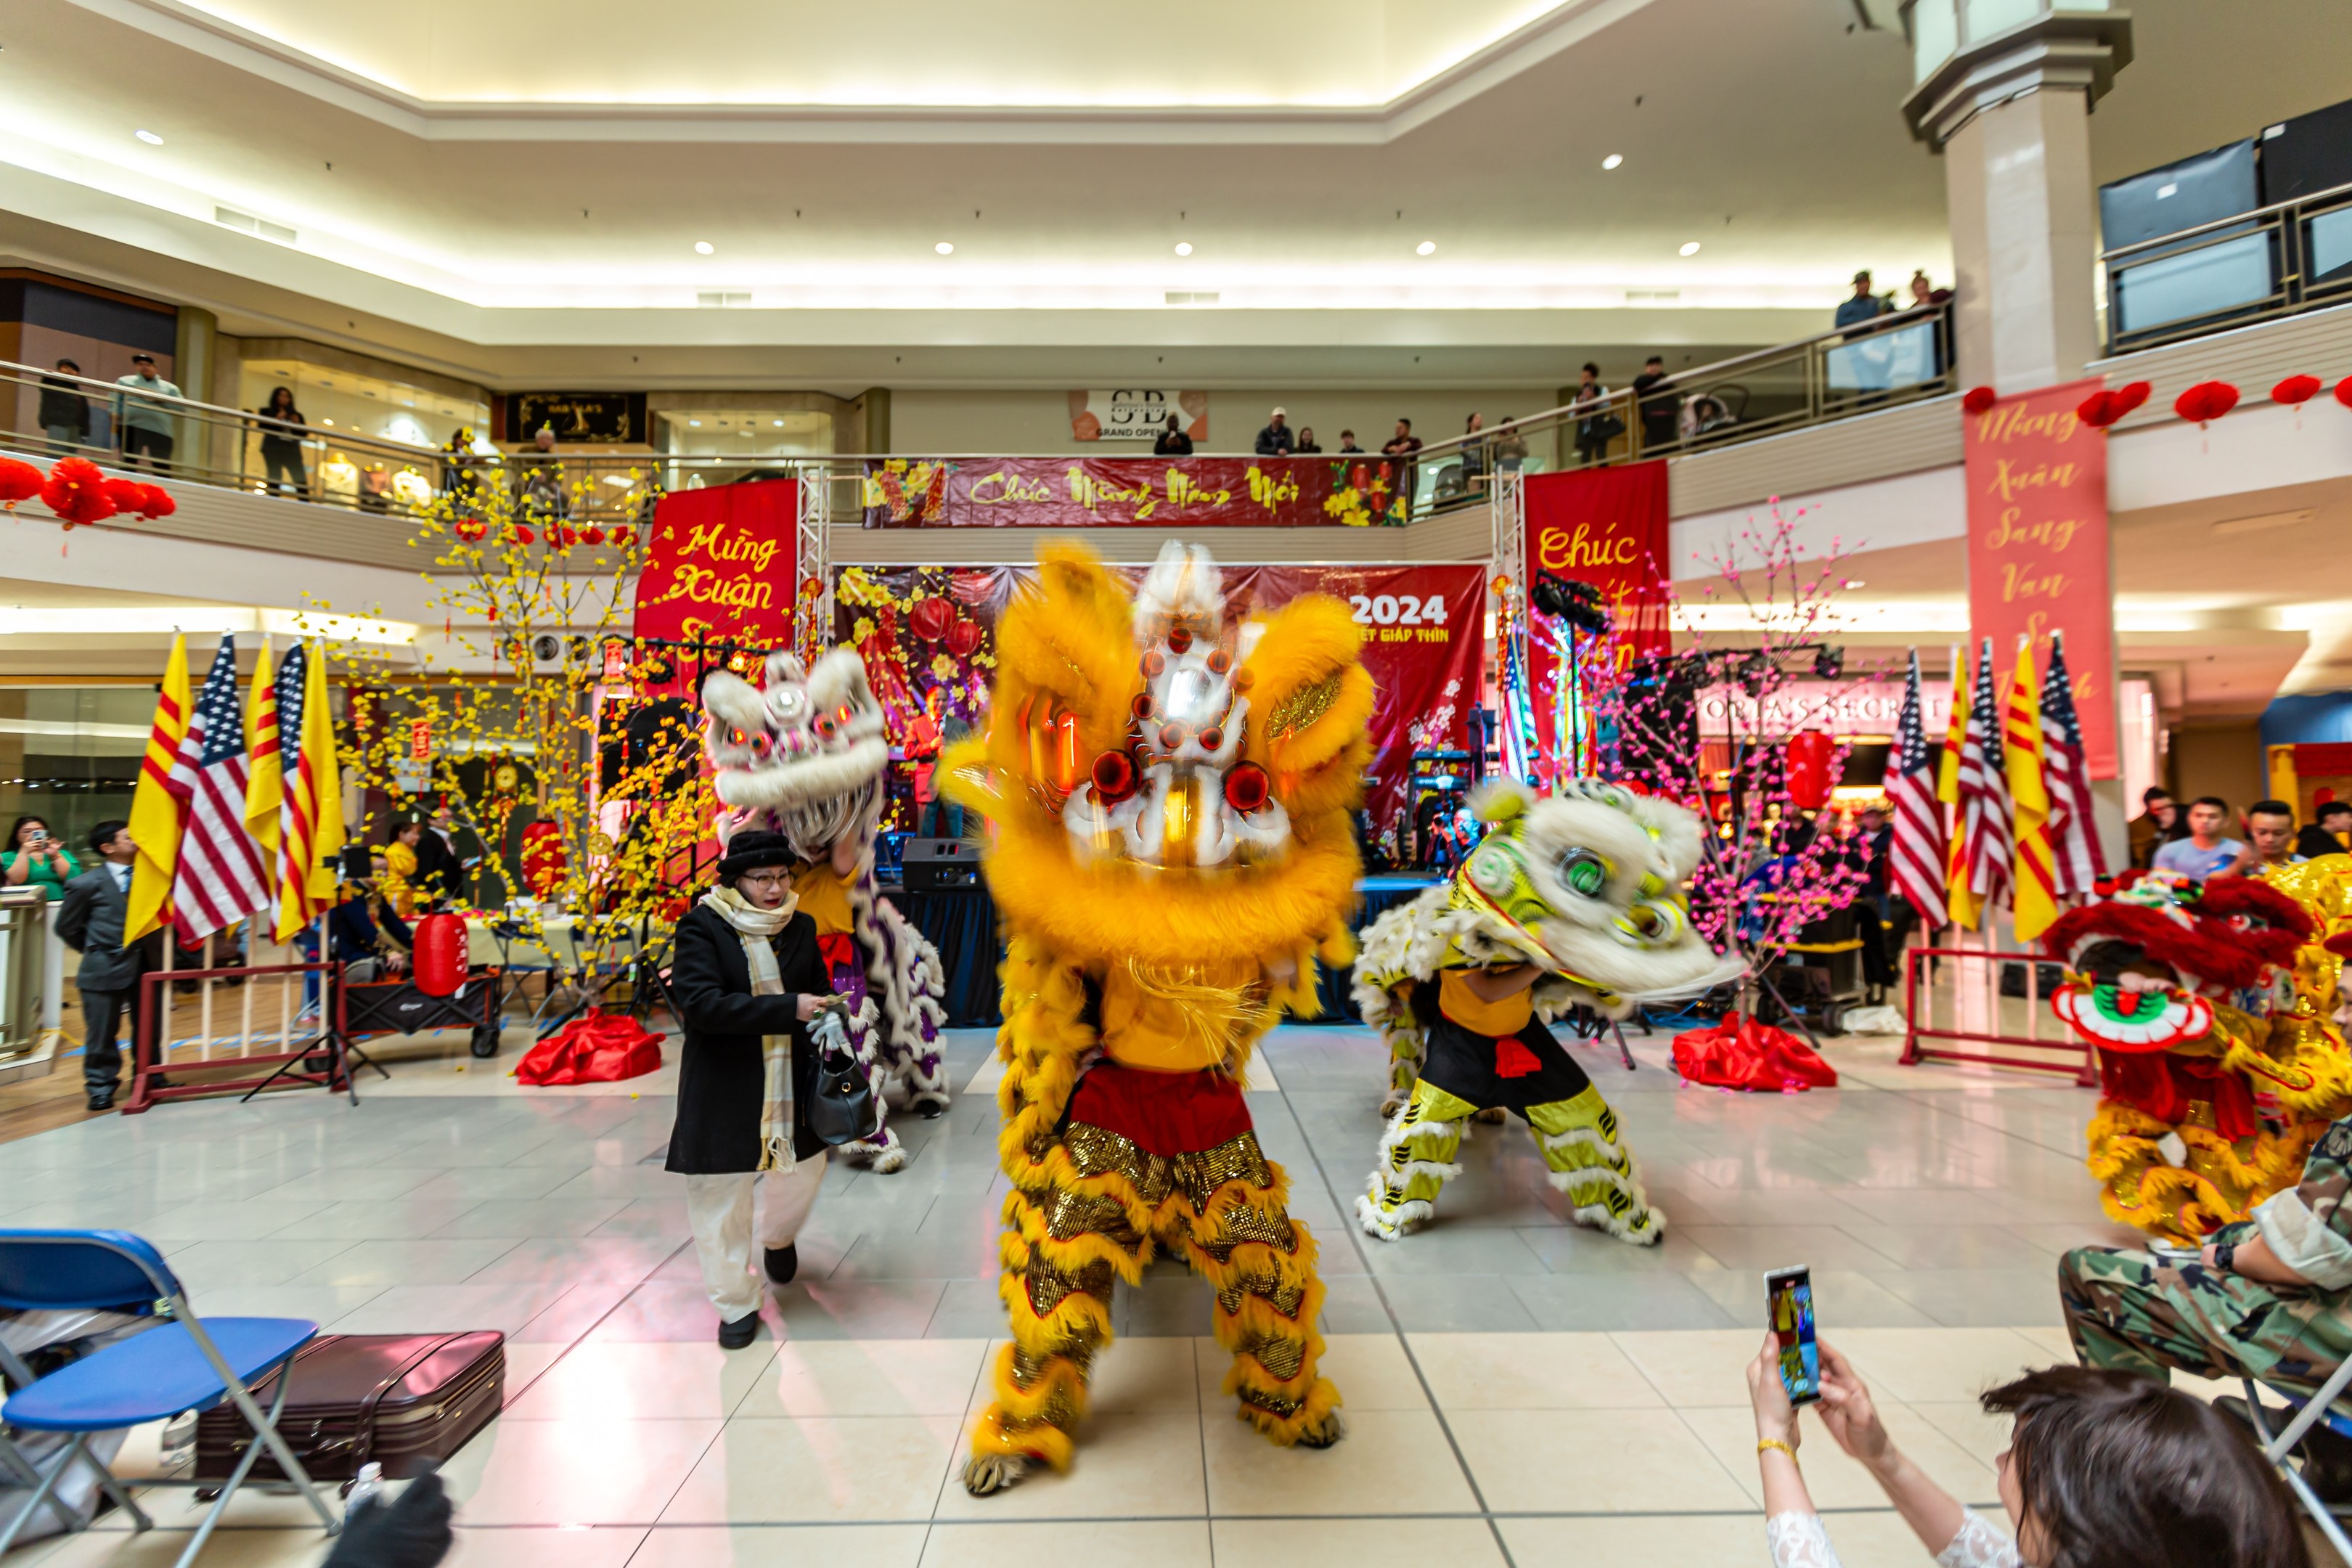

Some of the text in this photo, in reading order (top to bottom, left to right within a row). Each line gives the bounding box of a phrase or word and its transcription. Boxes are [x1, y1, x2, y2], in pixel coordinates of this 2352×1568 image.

[1096, 428, 1132, 437] GRAND
[970, 472, 1053, 504] Chúc
[1986, 458, 2083, 502] Xuân
[1985, 506, 2088, 552] Sang
[677, 523, 781, 573] Mừng
[1539, 522, 1638, 569] Chúc
[1349, 595, 1448, 625] 2024
[1380, 626, 1413, 642] GIÁP
[1416, 626, 1449, 642] THÌN
[1824, 698, 1943, 719] SECRT
